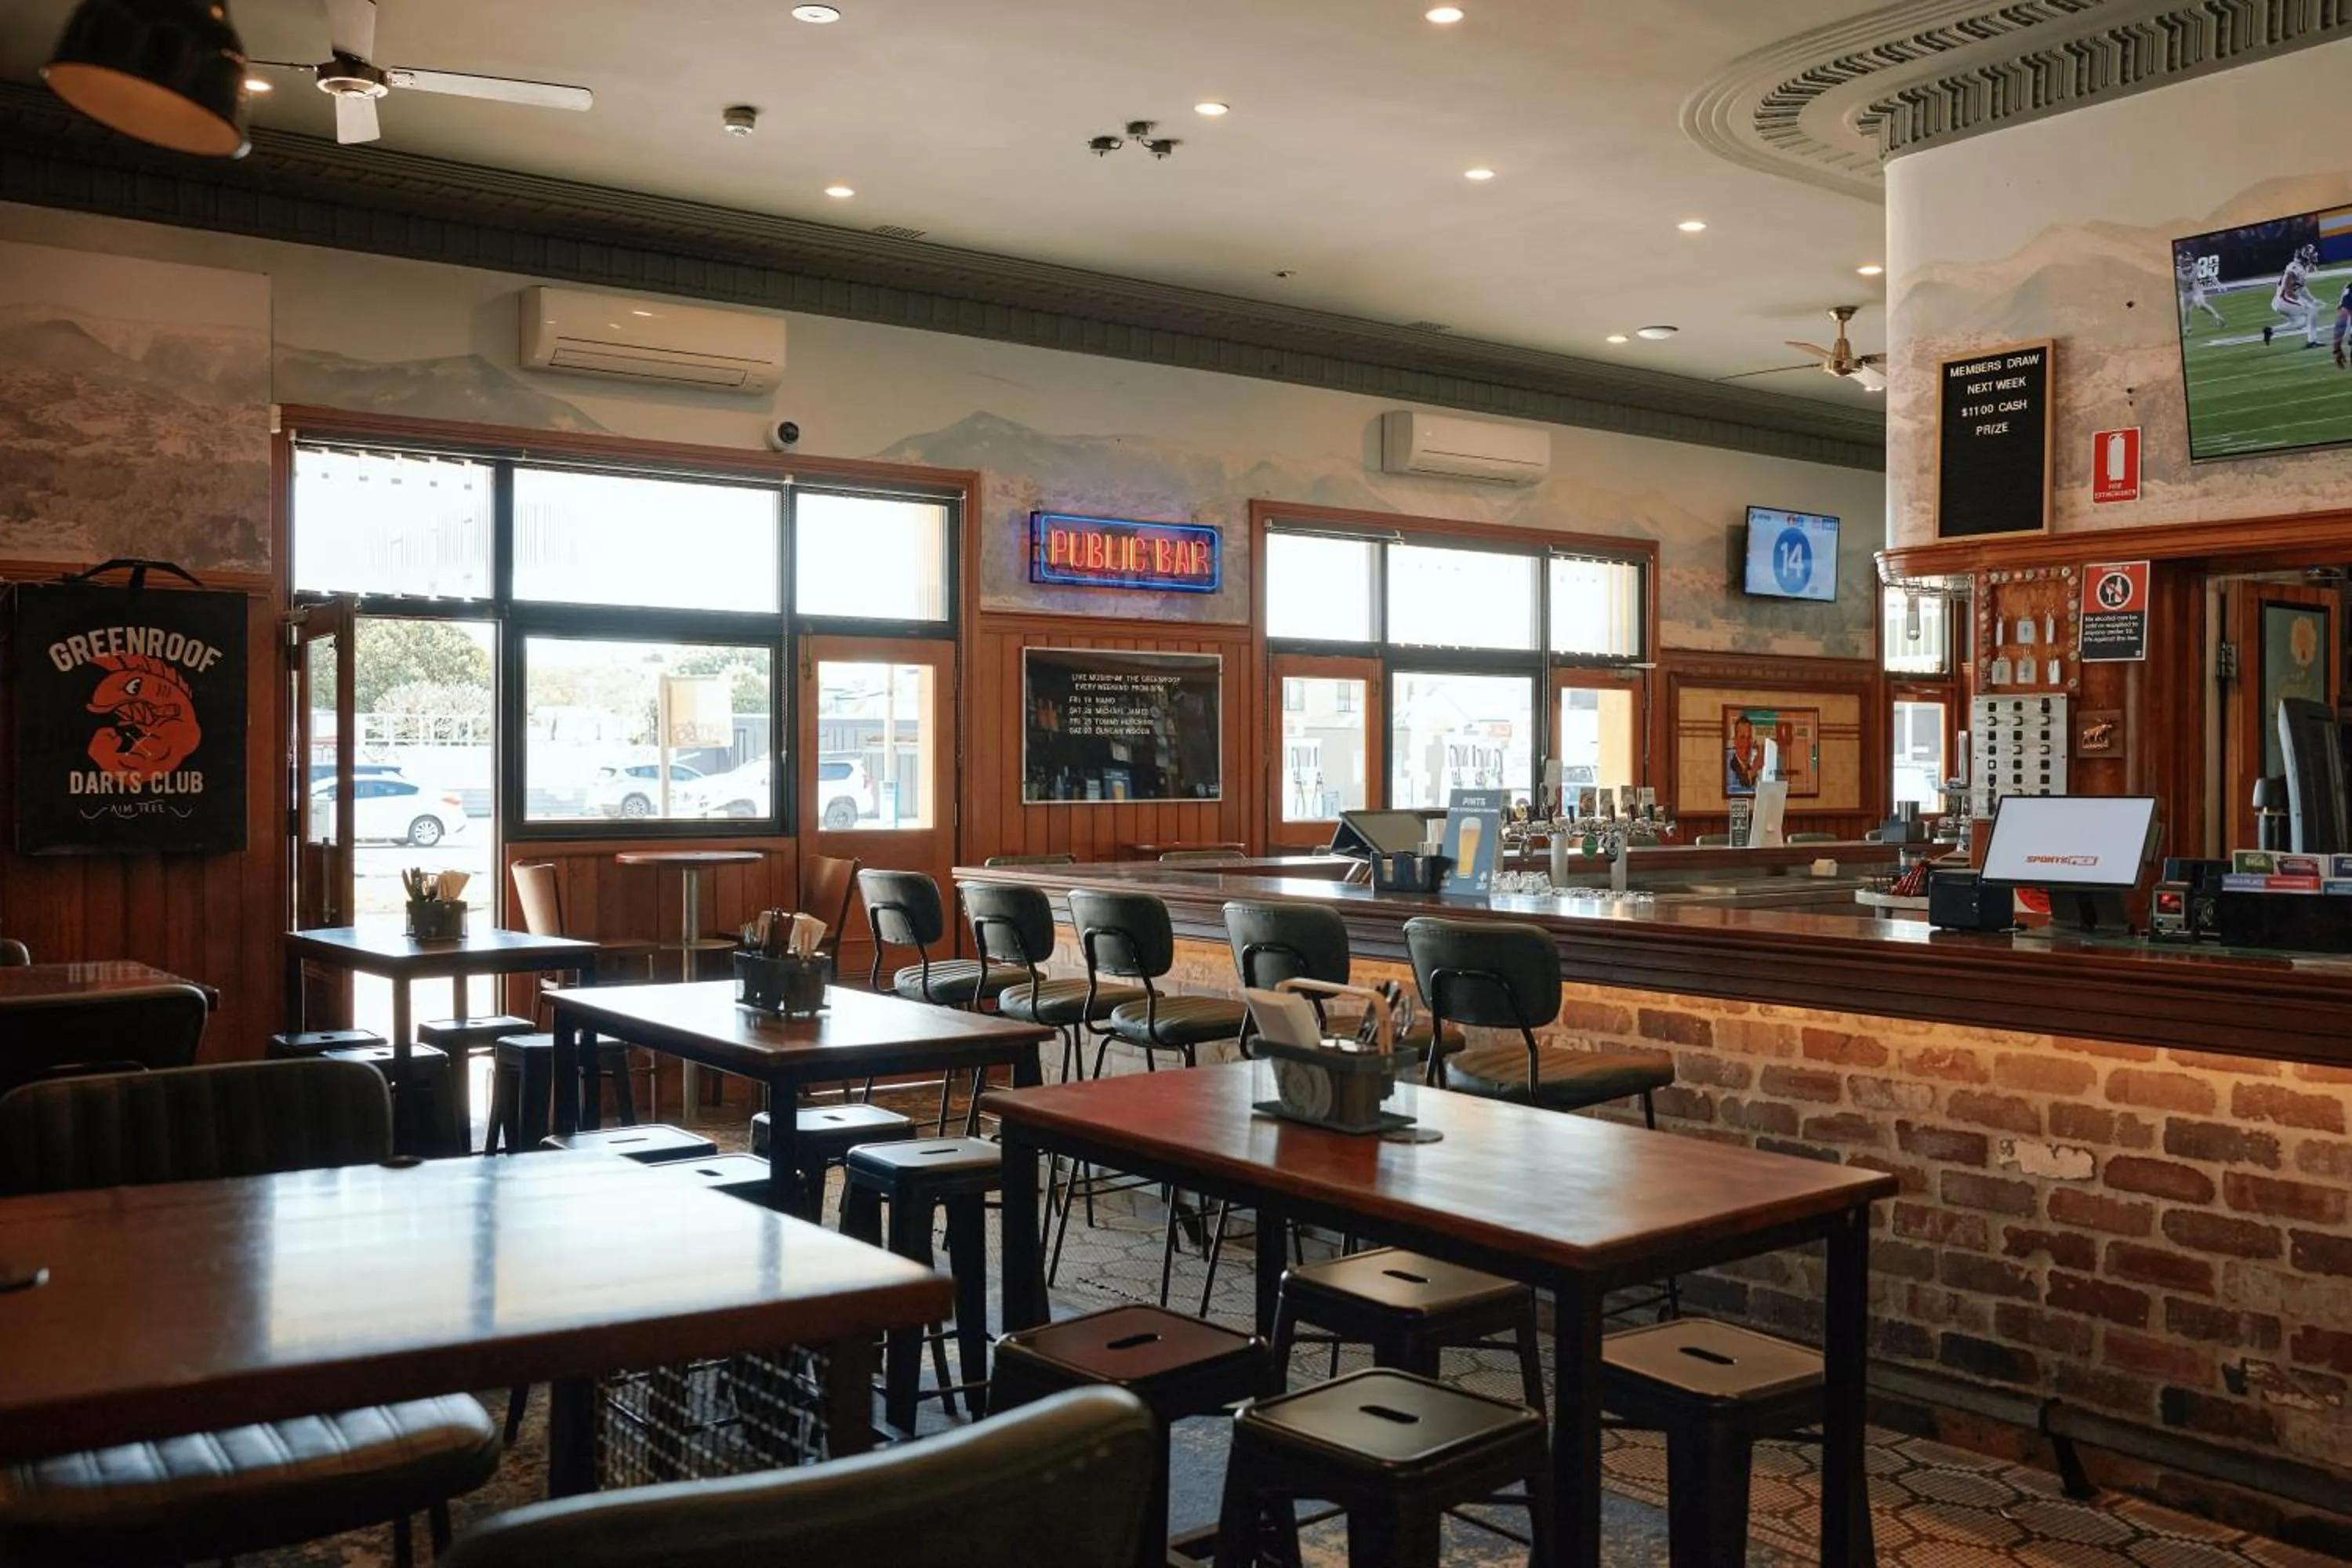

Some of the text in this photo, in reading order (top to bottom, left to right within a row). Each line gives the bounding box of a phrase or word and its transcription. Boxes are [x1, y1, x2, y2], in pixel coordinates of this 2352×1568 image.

[1950, 354, 2040, 377] MEMBERS DRAW
[1967, 376, 2027, 395] NEXT WEEK
[1998, 399, 2027, 412] CASH
[1976, 422, 2009, 437] PRIZE
[1051, 529, 1209, 575] PUBLIC BAR
[1780, 541, 1805, 579] 14
[48, 626, 223, 673] GREENROOF
[70, 771, 204, 794] DARTS CLUB
